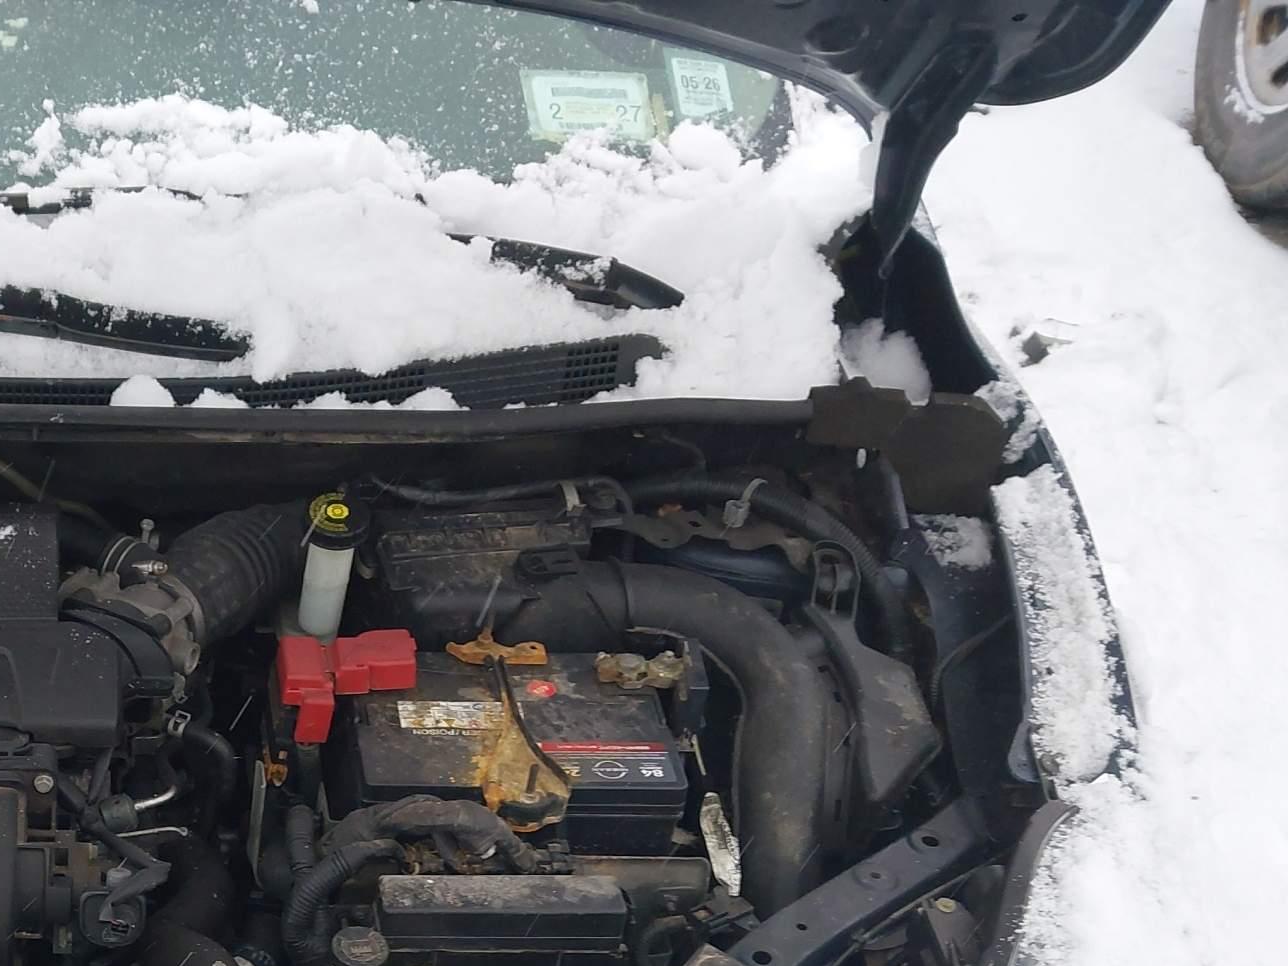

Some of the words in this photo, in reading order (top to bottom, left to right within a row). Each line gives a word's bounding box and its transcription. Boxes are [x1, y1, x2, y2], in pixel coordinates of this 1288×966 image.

[680, 74, 699, 89] 05
[703, 76, 721, 92] 26
[549, 102, 564, 120] 2
[615, 104, 641, 123] 27
[639, 768, 665, 777] 84
